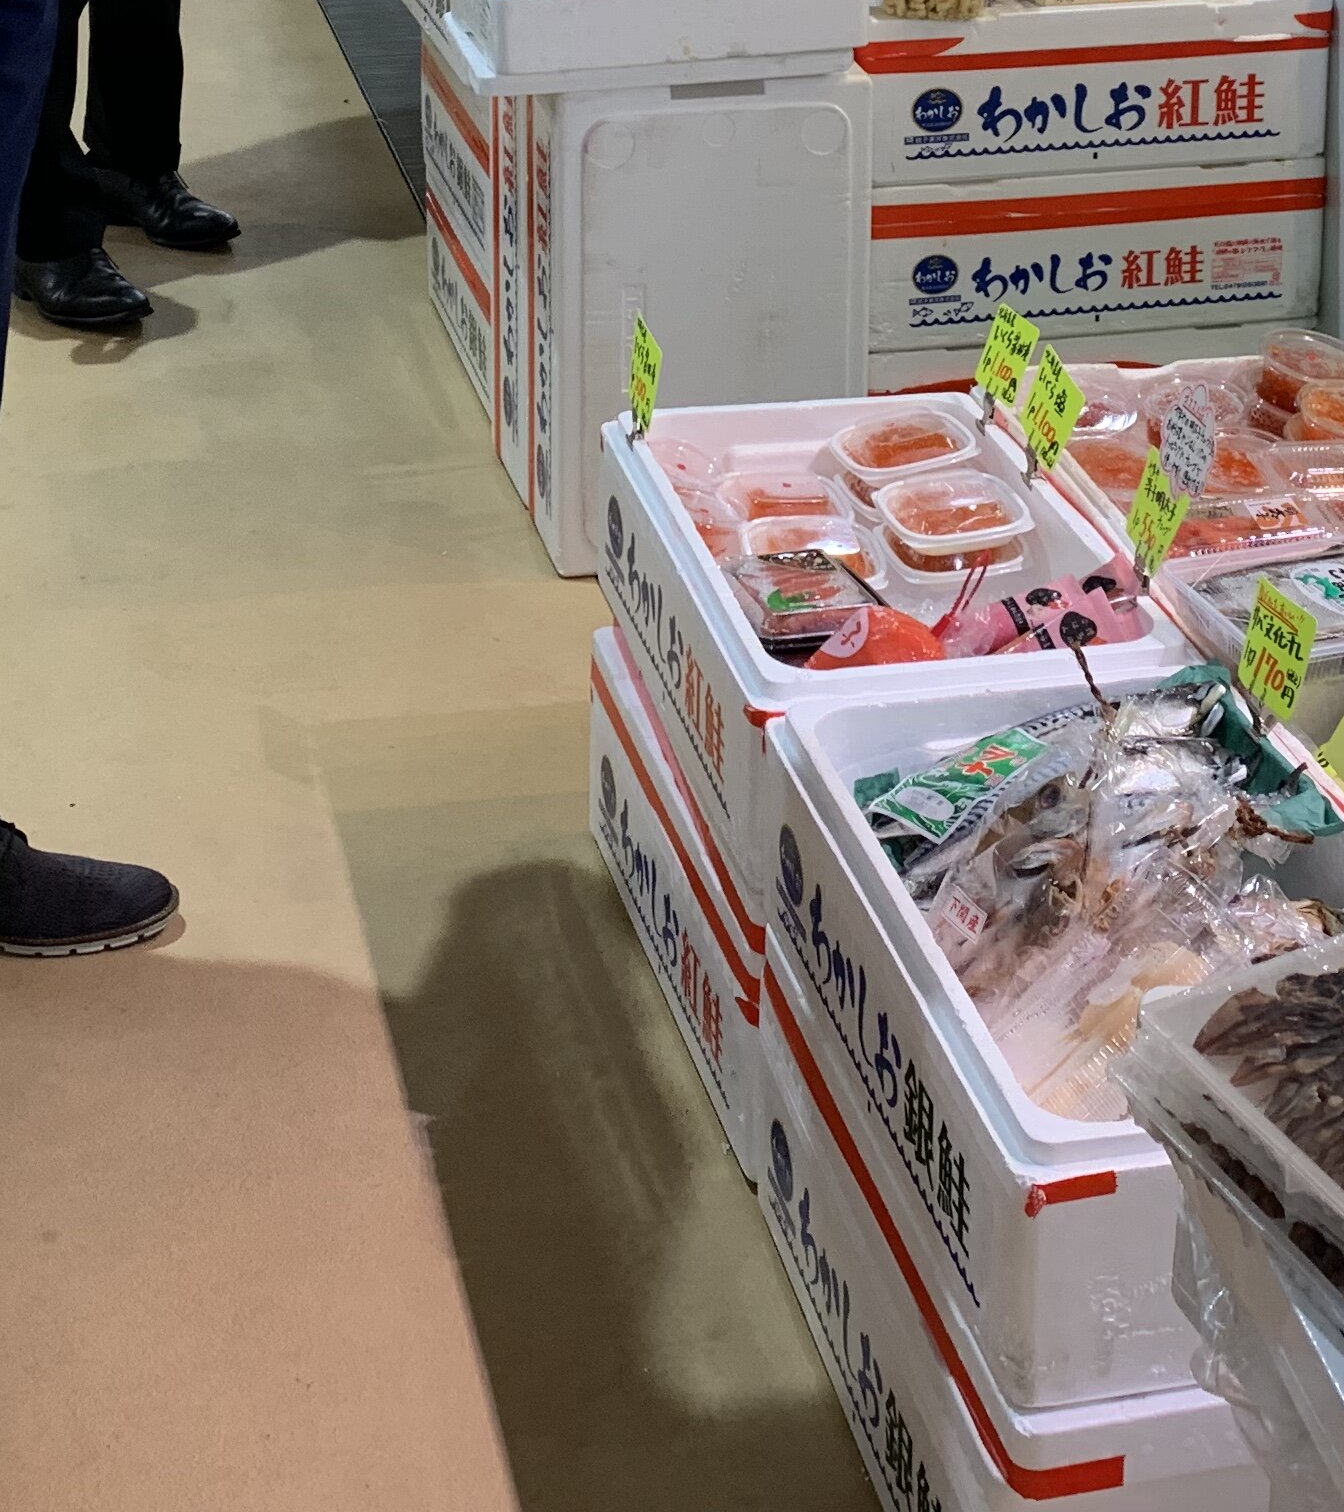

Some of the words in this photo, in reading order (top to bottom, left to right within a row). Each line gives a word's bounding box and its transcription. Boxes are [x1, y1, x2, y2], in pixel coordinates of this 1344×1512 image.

[977, 73, 1265, 144] わかしお紅鮭
[973, 245, 1206, 302] わかしお紅鮭
[1255, 646, 1284, 691] 170
